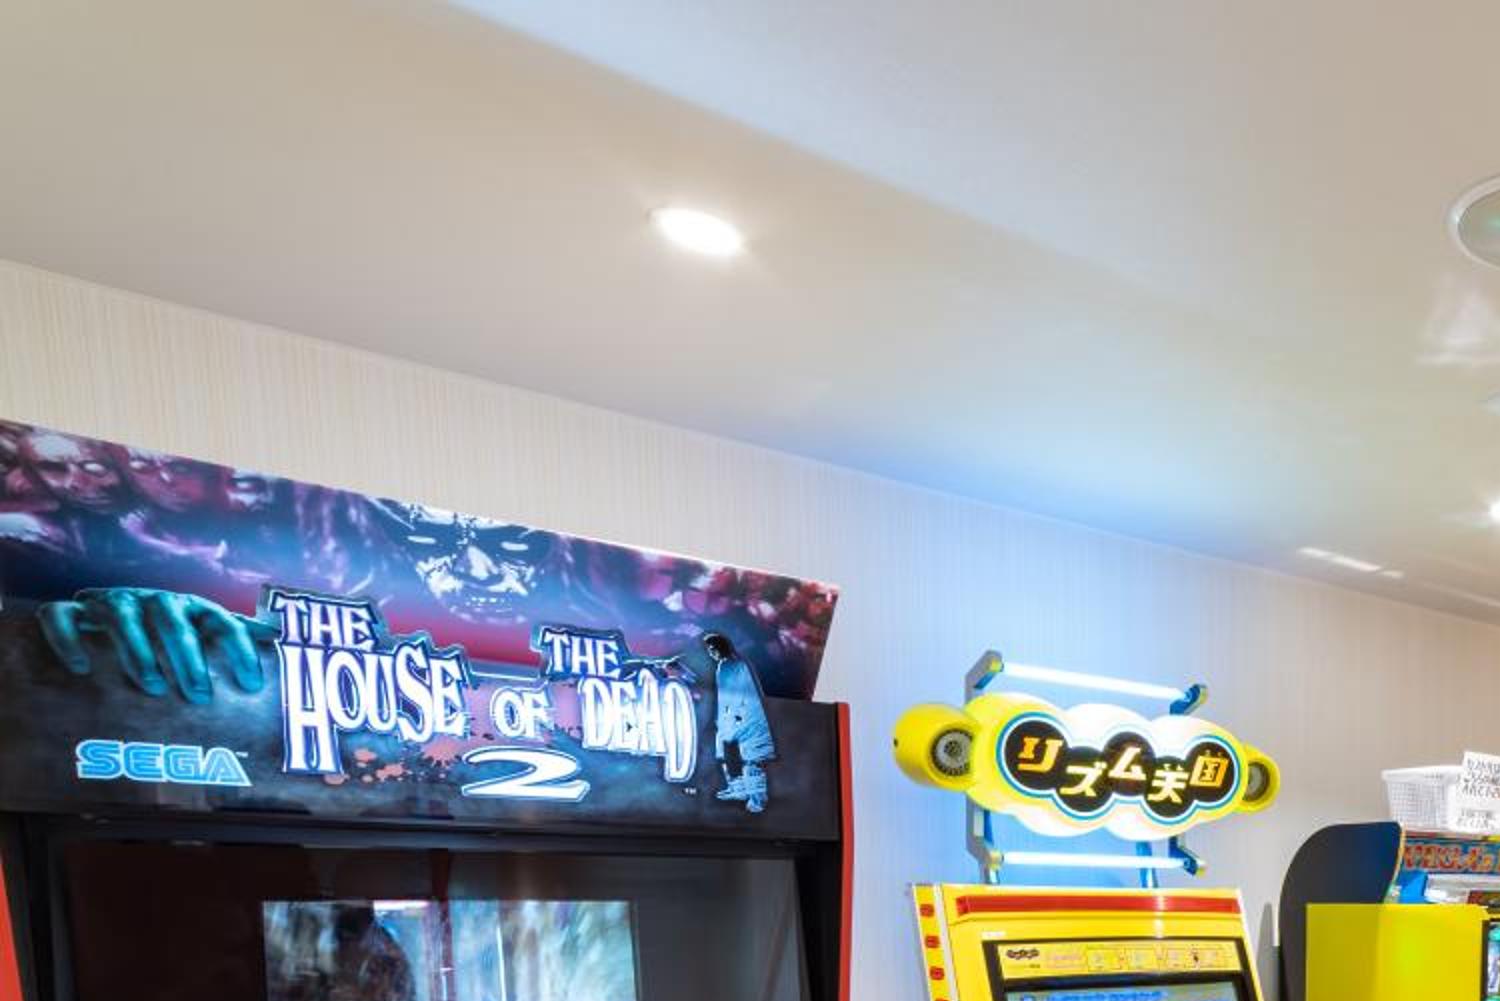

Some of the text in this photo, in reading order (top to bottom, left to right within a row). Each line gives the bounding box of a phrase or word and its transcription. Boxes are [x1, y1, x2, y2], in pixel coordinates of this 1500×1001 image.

[274, 591, 376, 650] THE
[541, 632, 622, 677] THE
[279, 642, 696, 783] HOUSE OF DEAD
[75, 739, 251, 787] SEGA
[462, 749, 590, 802] 2
[1017, 736, 1229, 803] リズム天国
